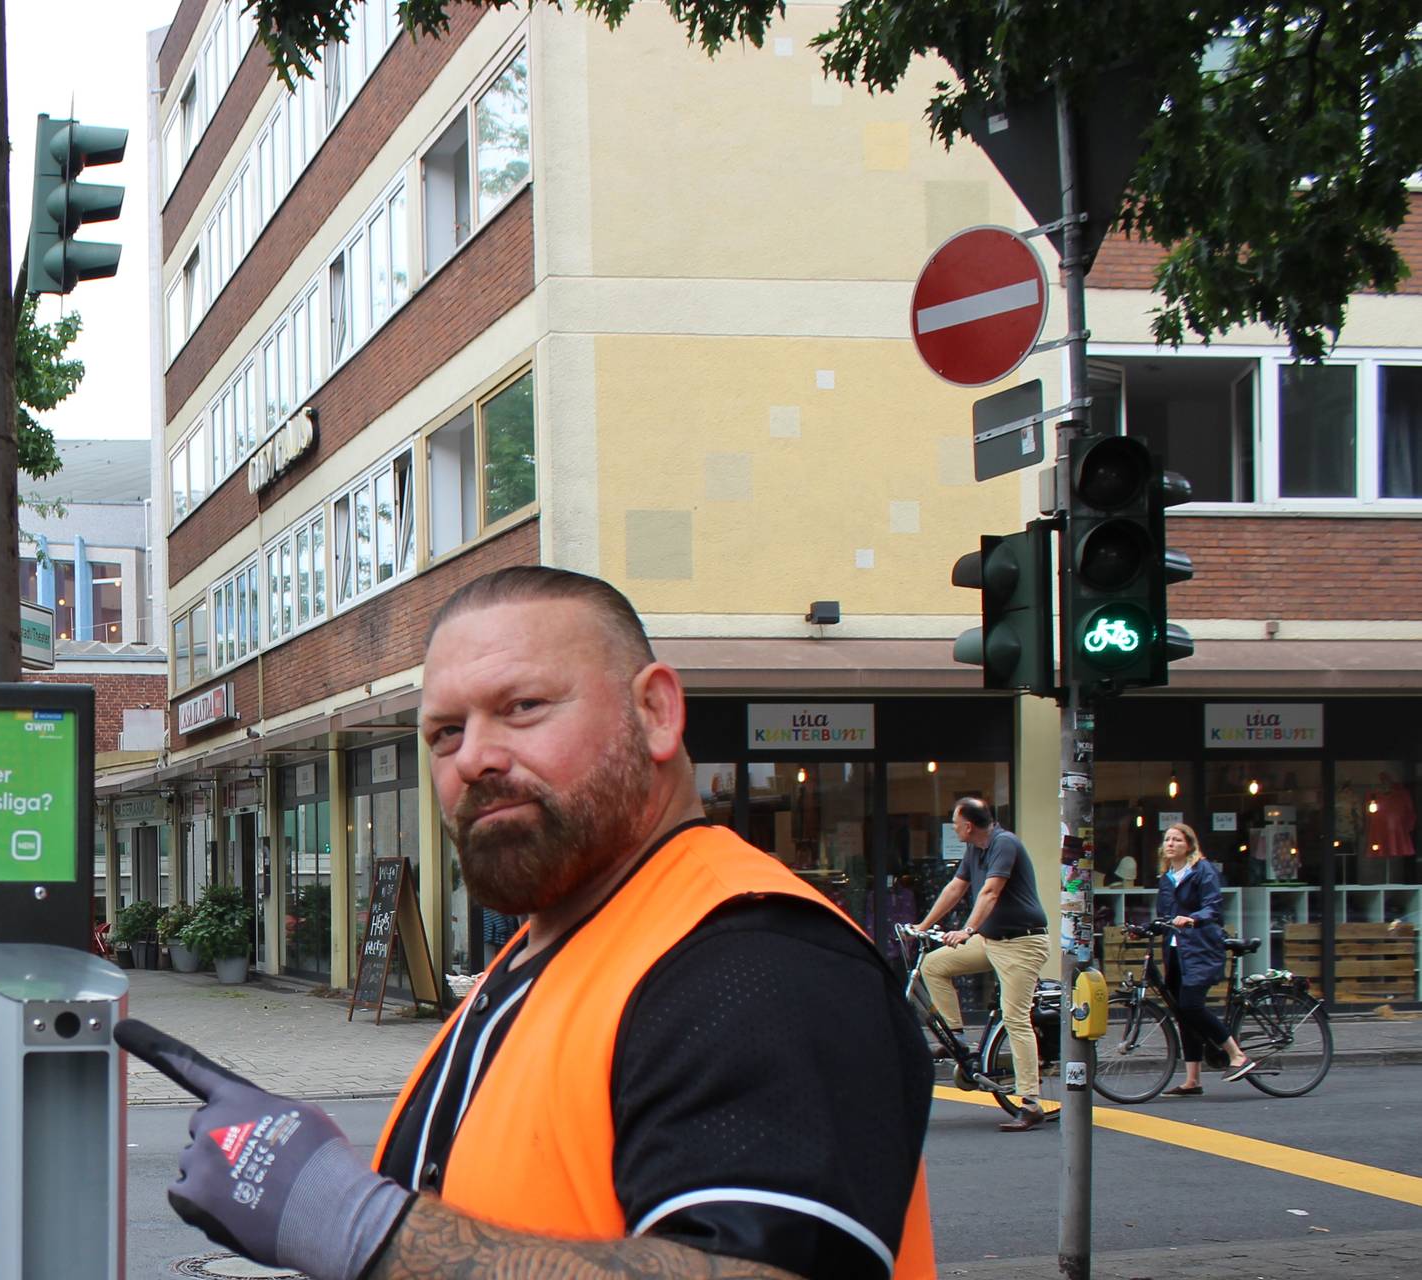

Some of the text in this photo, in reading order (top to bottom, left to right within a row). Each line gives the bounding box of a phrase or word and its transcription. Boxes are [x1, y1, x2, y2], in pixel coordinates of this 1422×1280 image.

[24, 721, 56, 731] awm
[230, 1138, 259, 1180] PADUA
[253, 1115, 274, 1138] PRO
[263, 1152, 276, 1166] 10
